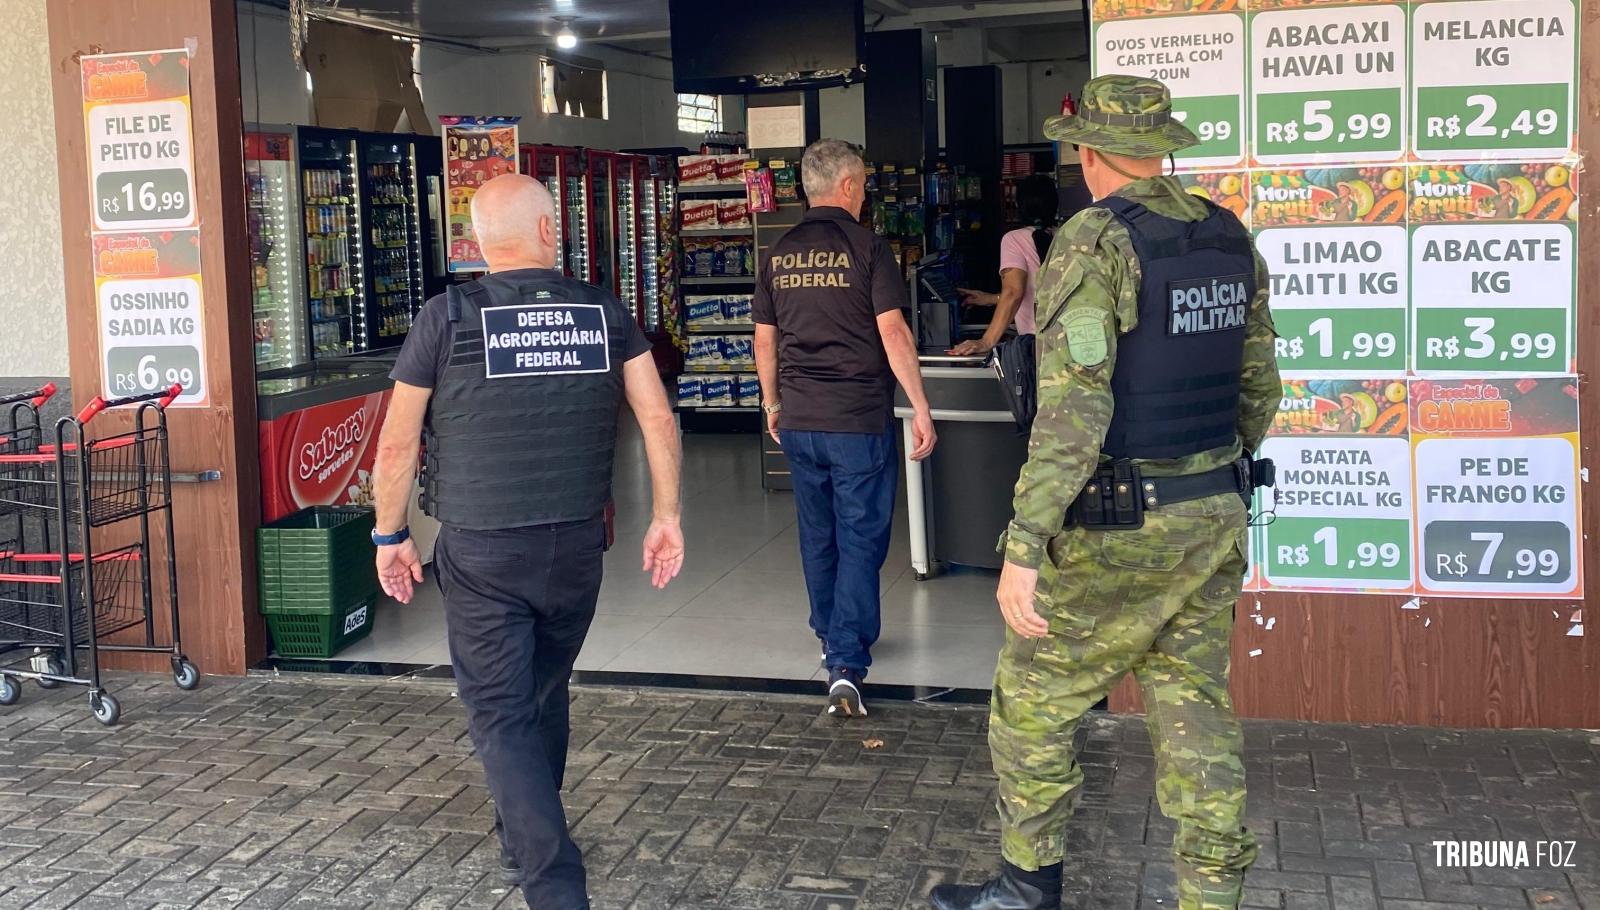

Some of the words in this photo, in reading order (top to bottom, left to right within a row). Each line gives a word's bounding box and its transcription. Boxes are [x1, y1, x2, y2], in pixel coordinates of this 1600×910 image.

[1266, 21, 1389, 48] ABACAXI
[1424, 17, 1564, 41] MELANCIA
[1105, 37, 1145, 51] OVOS
[1150, 32, 1234, 49] VERMELHO
[1116, 52, 1184, 67] CARTELA
[1189, 49, 1223, 63] COM
[1262, 53, 1344, 78] HAVAI
[1355, 51, 1395, 74] UN
[1475, 47, 1510, 67] KG
[1149, 67, 1190, 81] 20UN
[105, 116, 144, 135] FILE
[148, 114, 171, 132] DE
[1266, 119, 1299, 143] R$
[1303, 100, 1391, 142] 5,99
[1427, 114, 1461, 139] R$
[1465, 94, 1558, 139] 2,49
[100, 141, 151, 161] PEITO
[156, 140, 180, 158] KG
[682, 164, 712, 177] Duetto
[103, 197, 120, 214] R$
[121, 181, 184, 212] 16,99
[1257, 185, 1312, 201] Horti
[1413, 180, 1472, 197] Horti
[684, 209, 713, 221] Duetto
[771, 248, 850, 272] POLÍCIA
[1284, 240, 1382, 264] LIMAO
[1422, 239, 1561, 262] ABACATE
[772, 273, 850, 291] FEDERAL
[1268, 273, 1347, 296] TAITI
[1359, 272, 1398, 295] KG
[1471, 271, 1511, 293] KG
[110, 292, 189, 311] OSSINHO
[1172, 279, 1247, 311] POLÍCIA
[517, 310, 574, 327] DEFESA
[689, 304, 719, 316] Duetto
[1172, 304, 1246, 334] MILITAR
[108, 318, 166, 336] SADIA
[170, 317, 194, 335] KG
[489, 327, 604, 349] AGROPECUÁRIA
[1308, 317, 1396, 360] 1,99
[1426, 336, 1460, 360] R$
[1464, 317, 1556, 361] 3,99
[515, 350, 582, 368] FEDERAL
[116, 372, 137, 392] R$
[679, 385, 701, 394] Duetto
[707, 384, 730, 394] Duetto
[1278, 397, 1315, 411] orti
[1275, 410, 1317, 427] ruti
[1419, 400, 1510, 431] CARNE
[299, 407, 366, 480] Sabory
[1301, 449, 1372, 465] BATATA
[1460, 457, 1491, 477] PE
[1497, 457, 1529, 476] DE
[1284, 470, 1390, 486] MONALISA
[1274, 490, 1368, 507] ESPECIAL
[1376, 492, 1403, 508] KG
[1427, 484, 1527, 504] FRANGO
[1533, 485, 1565, 504] KG
[1277, 543, 1310, 567] R$
[1313, 526, 1400, 569] 1,99
[1437, 551, 1468, 577] R$
[1470, 532, 1559, 579] 7,99
